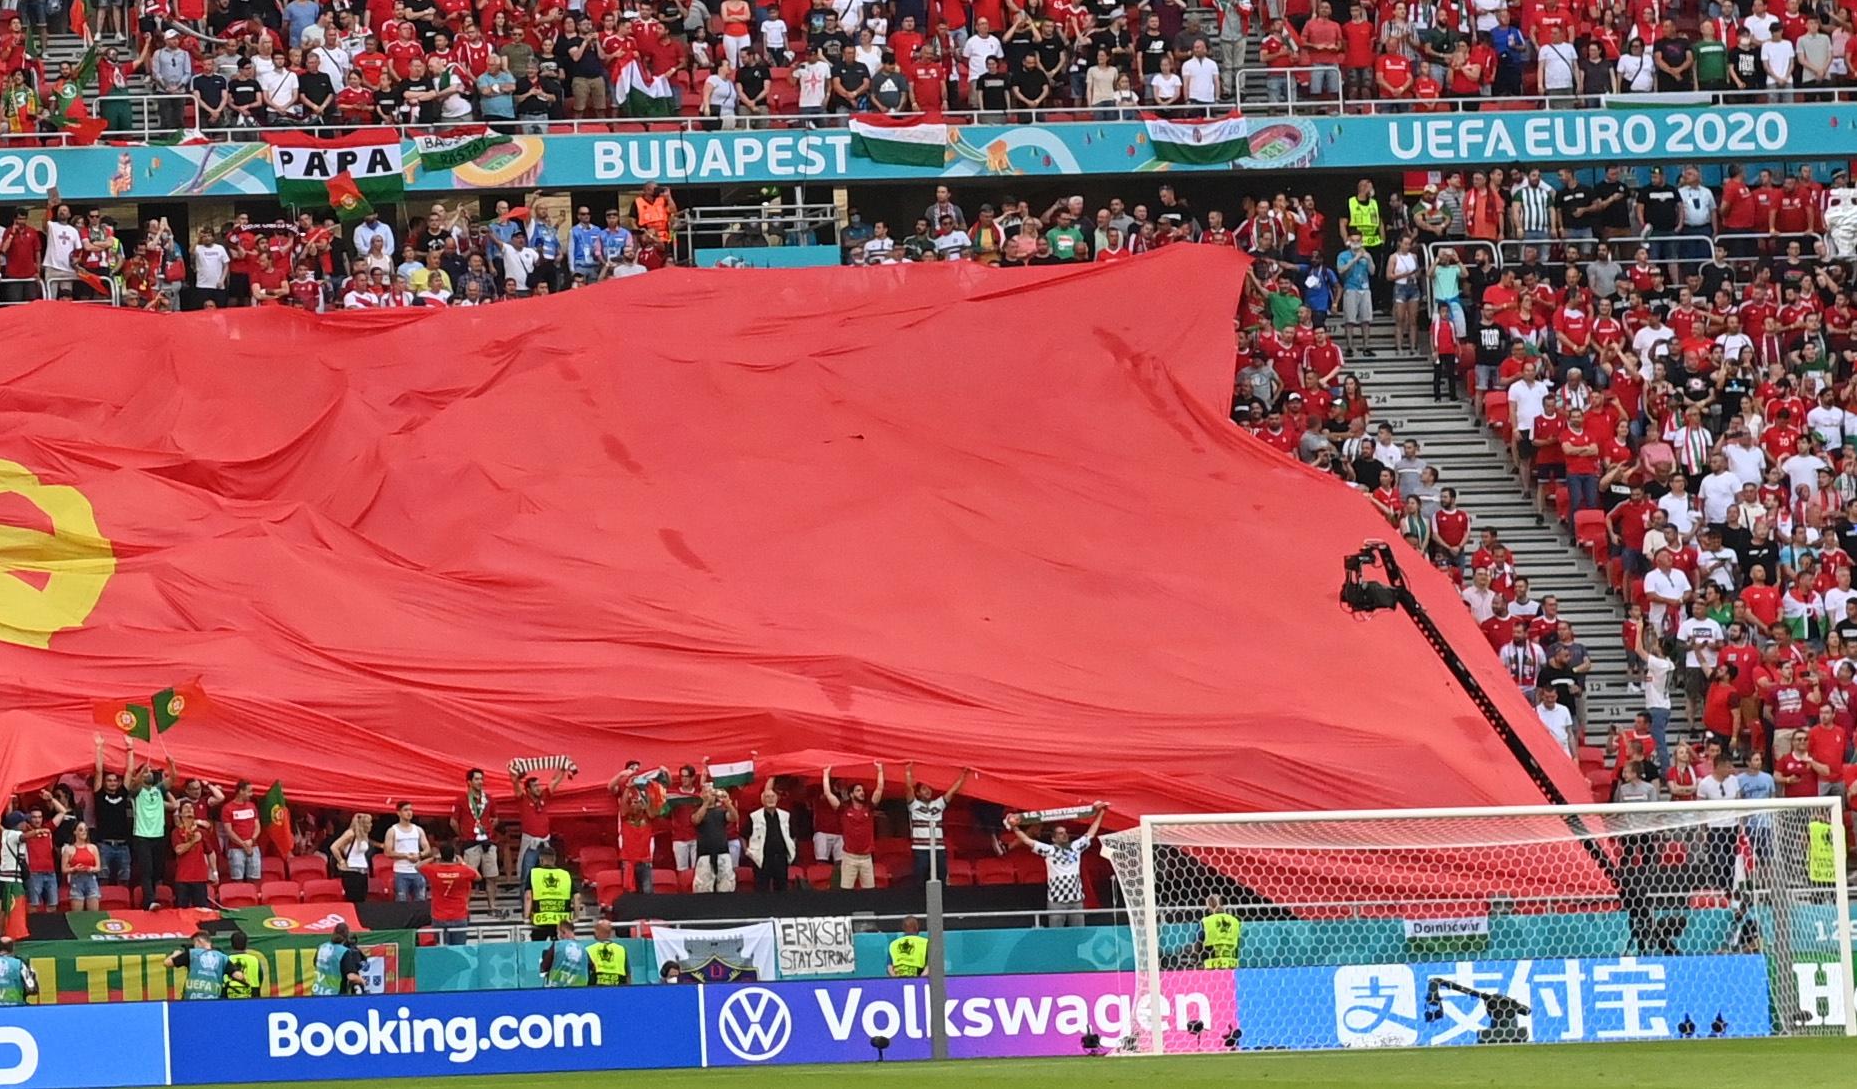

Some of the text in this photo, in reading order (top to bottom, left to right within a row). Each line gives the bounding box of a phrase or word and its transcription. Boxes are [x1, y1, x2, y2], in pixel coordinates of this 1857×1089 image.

[1389, 111, 1788, 159] UEFA EURO 2020
[280, 149, 394, 177] PÁPA
[594, 137, 852, 180] BUDAPEST
[1374, 396, 1387, 404] 24
[1590, 683, 1602, 692] 12
[1609, 707, 1621, 716] 11
[442, 879, 455, 897] 7
[782, 921, 851, 947] ERIKSEN
[780, 949, 813, 970] STAY
[268, 1007, 602, 1063] Booking.com
